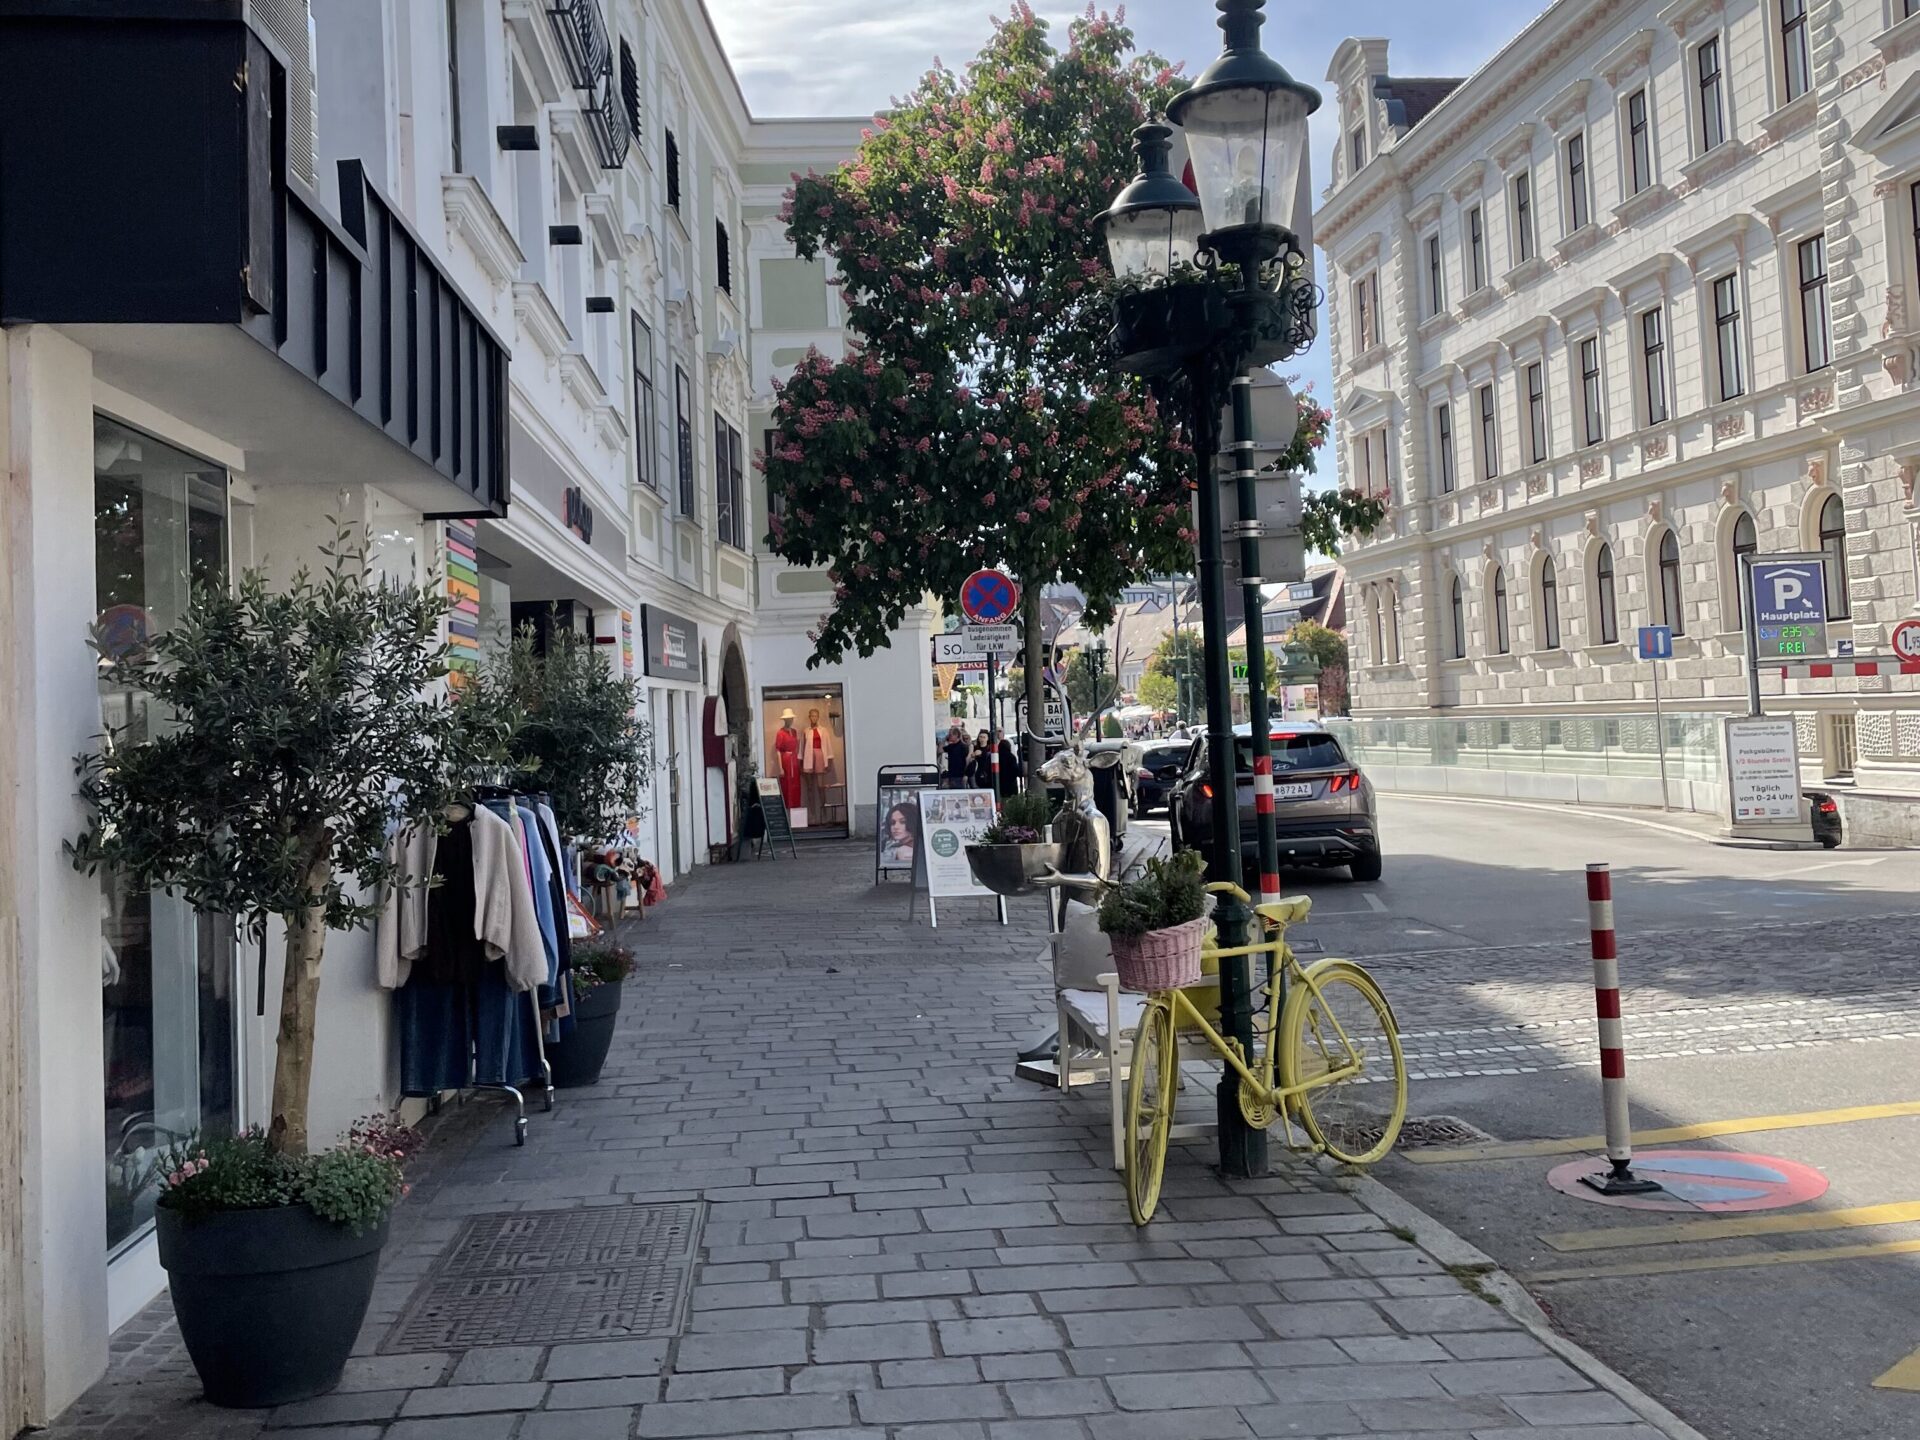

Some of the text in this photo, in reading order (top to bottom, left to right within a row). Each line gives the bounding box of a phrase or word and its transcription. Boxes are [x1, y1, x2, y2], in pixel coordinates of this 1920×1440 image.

[1774, 577, 1803, 610] P
[973, 612, 1007, 625] ANFANG
[1761, 611, 1821, 621] Hauptplatz
[1782, 626, 1802, 638] 235
[976, 643, 987, 651] für
[1778, 641, 1807, 653] FREI
[1751, 784, 1781, 793] Täglich
